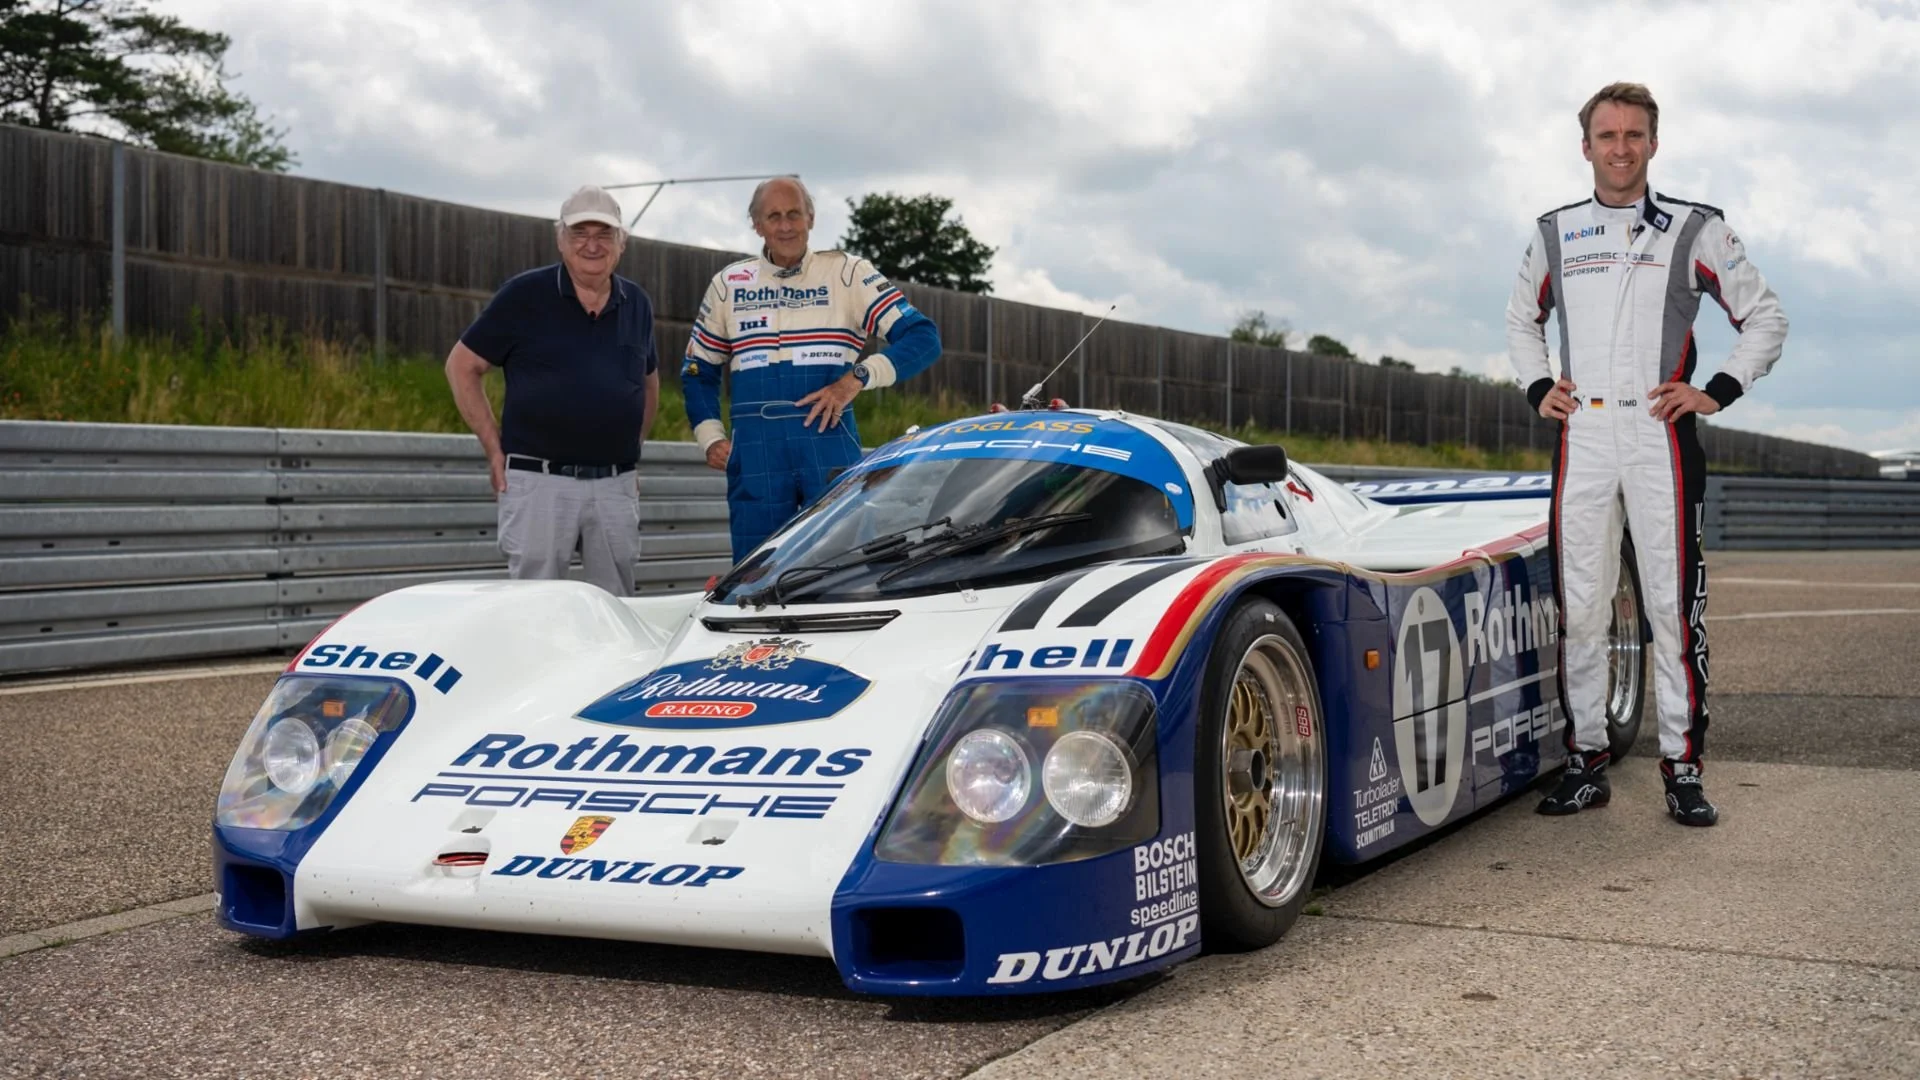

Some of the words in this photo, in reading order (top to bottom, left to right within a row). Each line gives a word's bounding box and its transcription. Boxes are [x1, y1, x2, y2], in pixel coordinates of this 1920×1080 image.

[1564, 226, 1594, 242] Mobil
[1563, 266, 1610, 278] MOTORSPORT
[734, 286, 829, 303] Rothmans
[1617, 399, 1637, 407] TIMO
[1464, 583, 1560, 667] Rothm
[303, 643, 463, 695] Shell
[618, 673, 829, 703] Rothmans
[660, 704, 744, 717] RACING
[1297, 707, 1310, 736] BBS
[1403, 617, 1450, 794] 17
[450, 733, 872, 778] Rothmans
[410, 783, 838, 819] PORSCHE
[1353, 777, 1400, 809] Turbolader
[1355, 797, 1398, 830] TELETRON
[1134, 831, 1195, 873] BOSCH
[491, 855, 747, 887] DUNLOP
[1135, 859, 1197, 902] BILSTEIN
[1131, 890, 1198, 928] speedline
[986, 913, 1199, 985] DUNLOP
